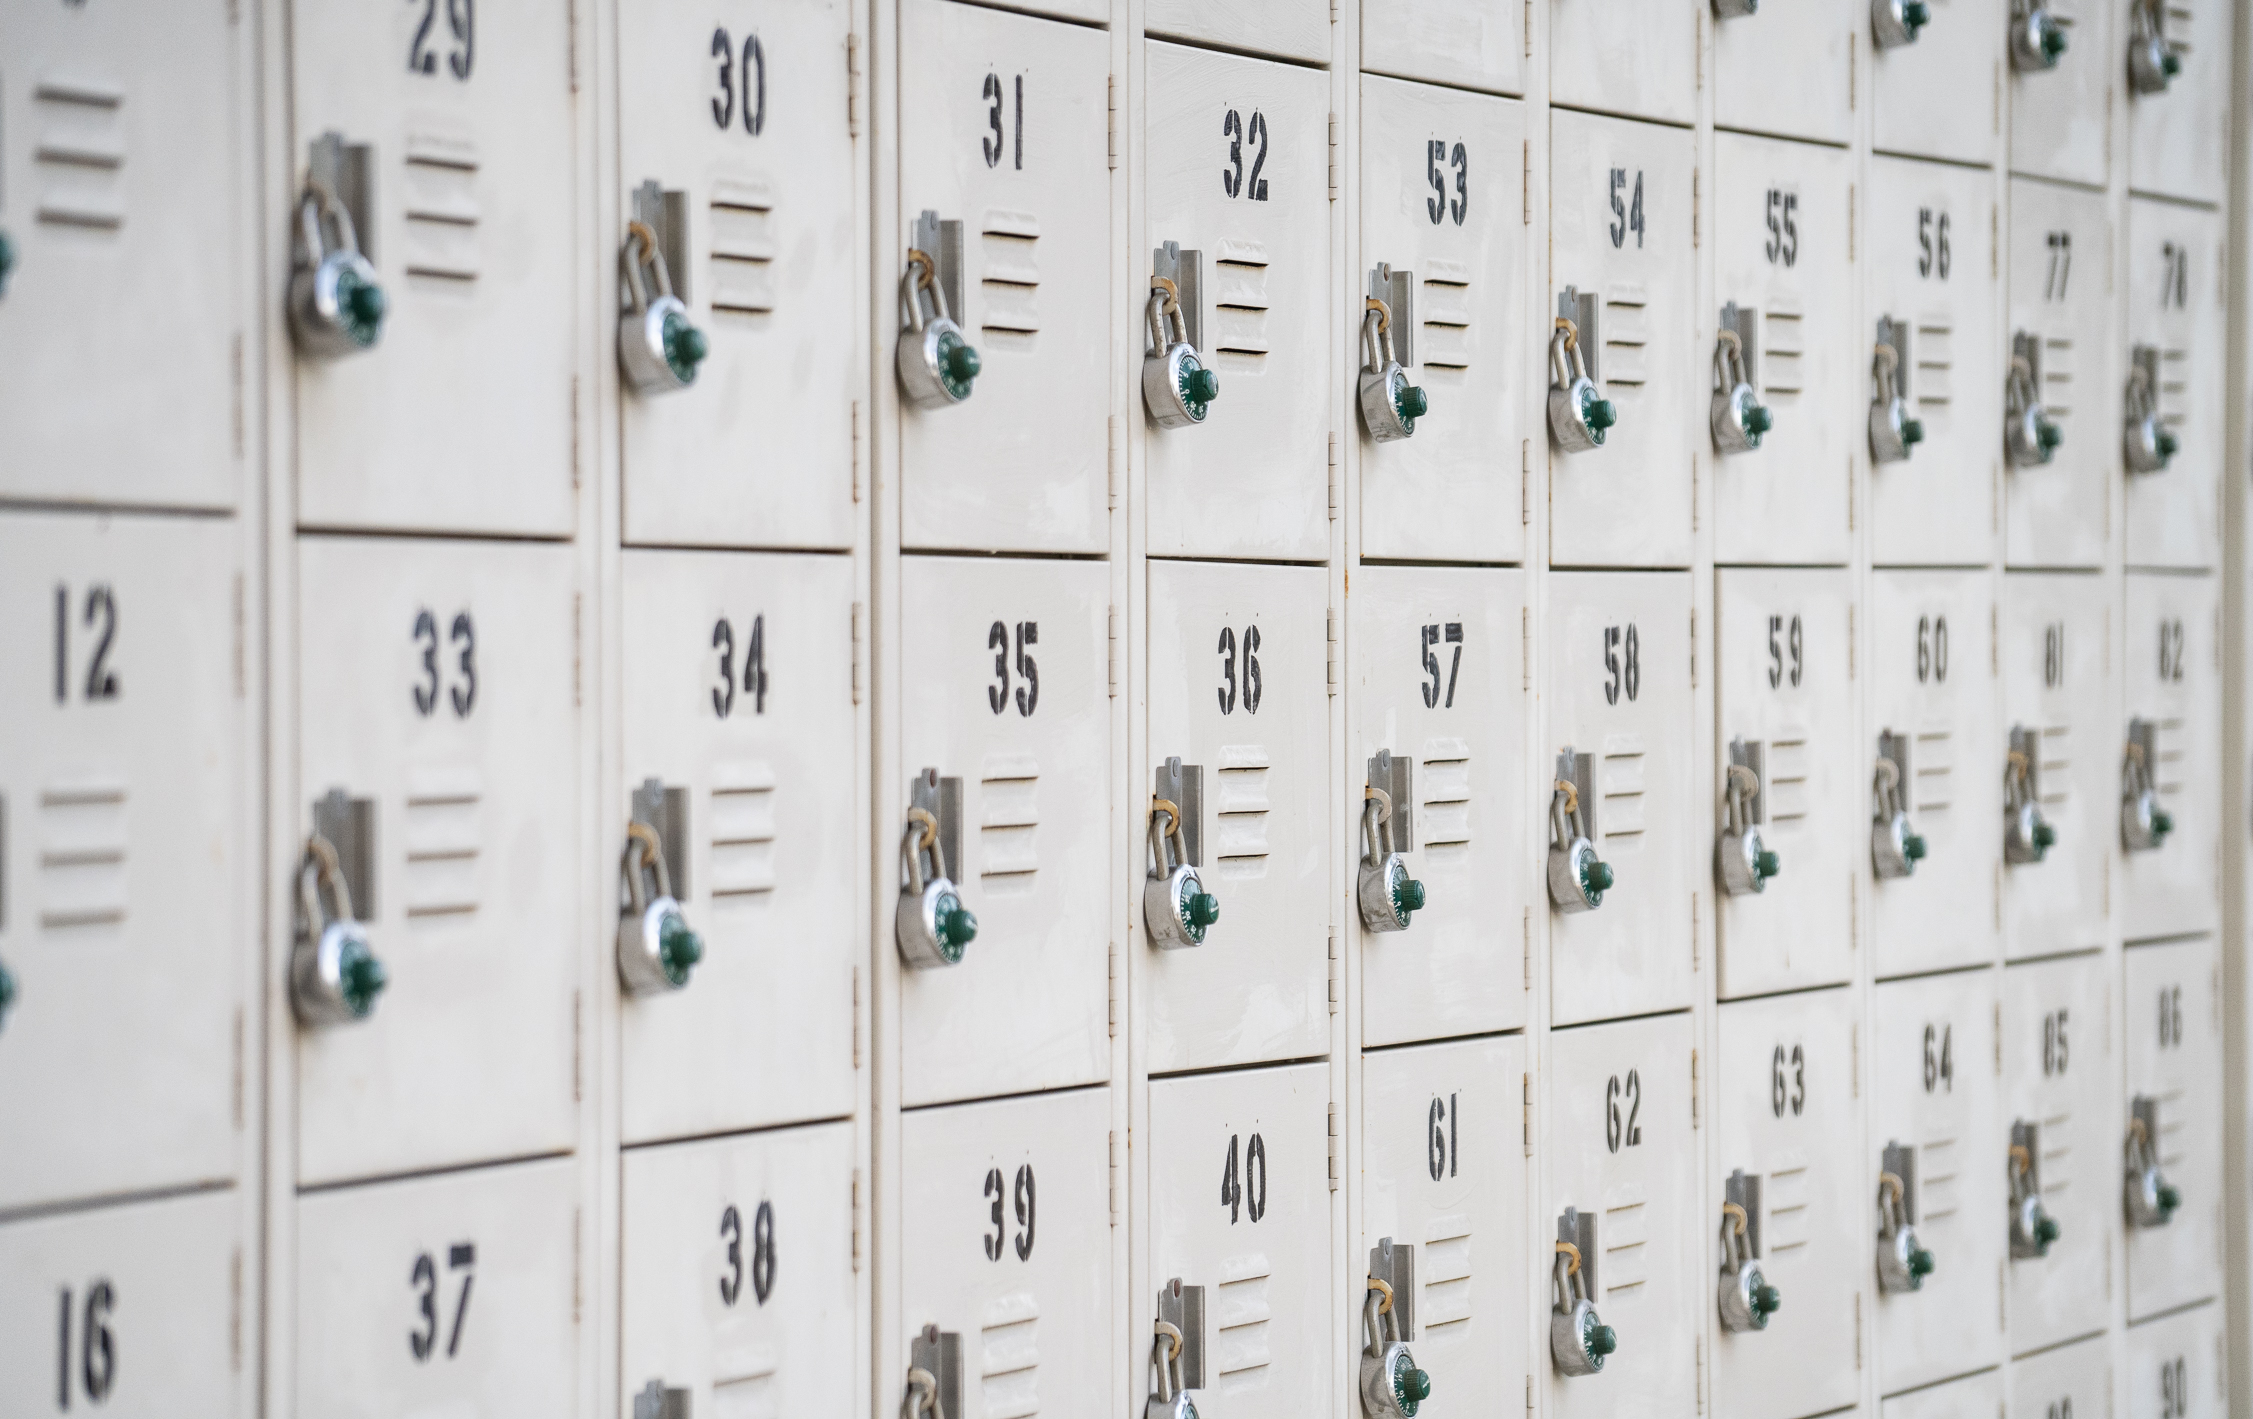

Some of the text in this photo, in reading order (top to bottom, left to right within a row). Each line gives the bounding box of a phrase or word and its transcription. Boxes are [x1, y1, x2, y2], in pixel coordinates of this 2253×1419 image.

[408, 0, 475, 81] 29
[710, 27, 766, 137] 30
[982, 73, 1023, 171] 31
[1223, 109, 1269, 202] 32
[1426, 139, 1468, 227] 53
[1609, 168, 1645, 249] 54
[1765, 189, 1798, 268] 55
[1918, 208, 1951, 280] 56
[2046, 231, 2072, 298] 77
[54, 586, 120, 704] 12
[412, 610, 477, 719] 33
[711, 614, 768, 718] 34
[988, 620, 1039, 718] 35
[1217, 624, 1262, 716] 36
[1421, 622, 1464, 709] 57
[1604, 623, 1640, 706] 58
[1768, 614, 1803, 690] 59
[1916, 616, 1948, 683] 60
[1772, 1044, 1805, 1119] 63
[1923, 1024, 1953, 1093] 64
[1428, 1093, 1458, 1182] 61
[1606, 1069, 1641, 1154] 62
[983, 1163, 1036, 1263] 39
[1221, 1132, 1267, 1226] 40
[719, 1200, 777, 1307] 38
[58, 1280, 116, 1411] 16
[409, 1242, 476, 1362] 37
